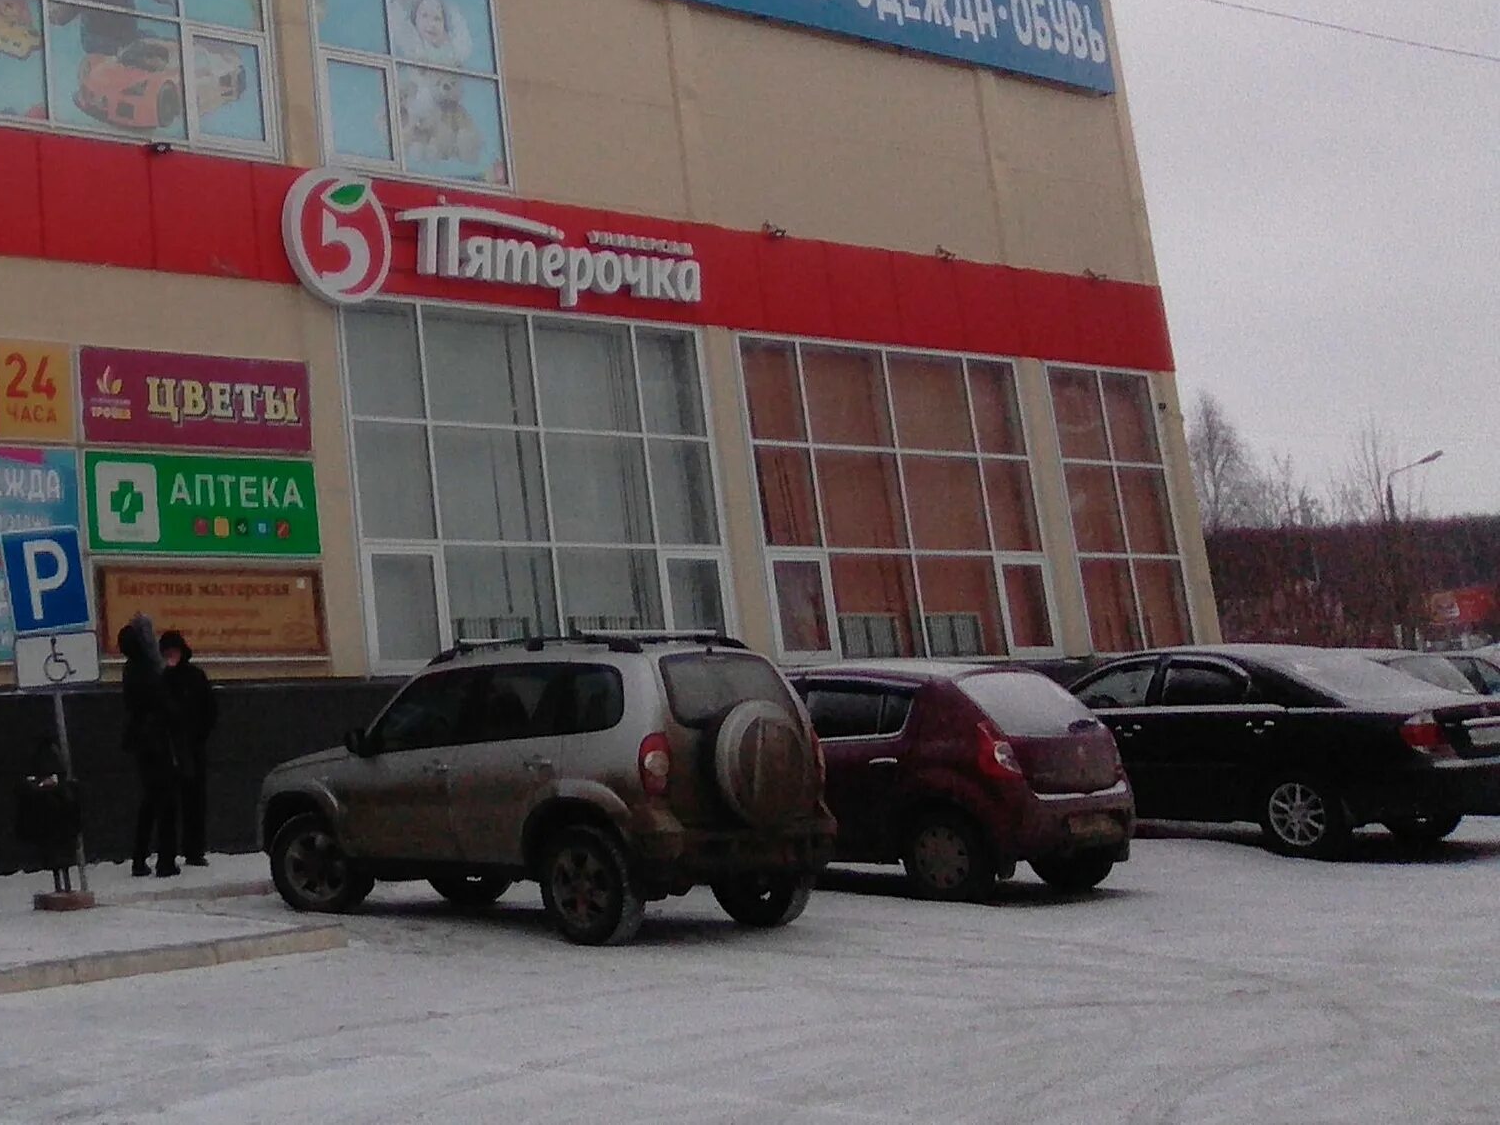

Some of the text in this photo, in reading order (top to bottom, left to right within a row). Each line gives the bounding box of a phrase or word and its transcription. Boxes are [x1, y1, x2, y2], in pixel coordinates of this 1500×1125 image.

[320, 207, 370, 291] 5
[4, 351, 58, 402] 24
[145, 375, 302, 427] ЦВЕТЫ
[5, 403, 58, 424] ЧАСА
[169, 472, 305, 510] АПТЕКА
[22, 538, 69, 621] P
